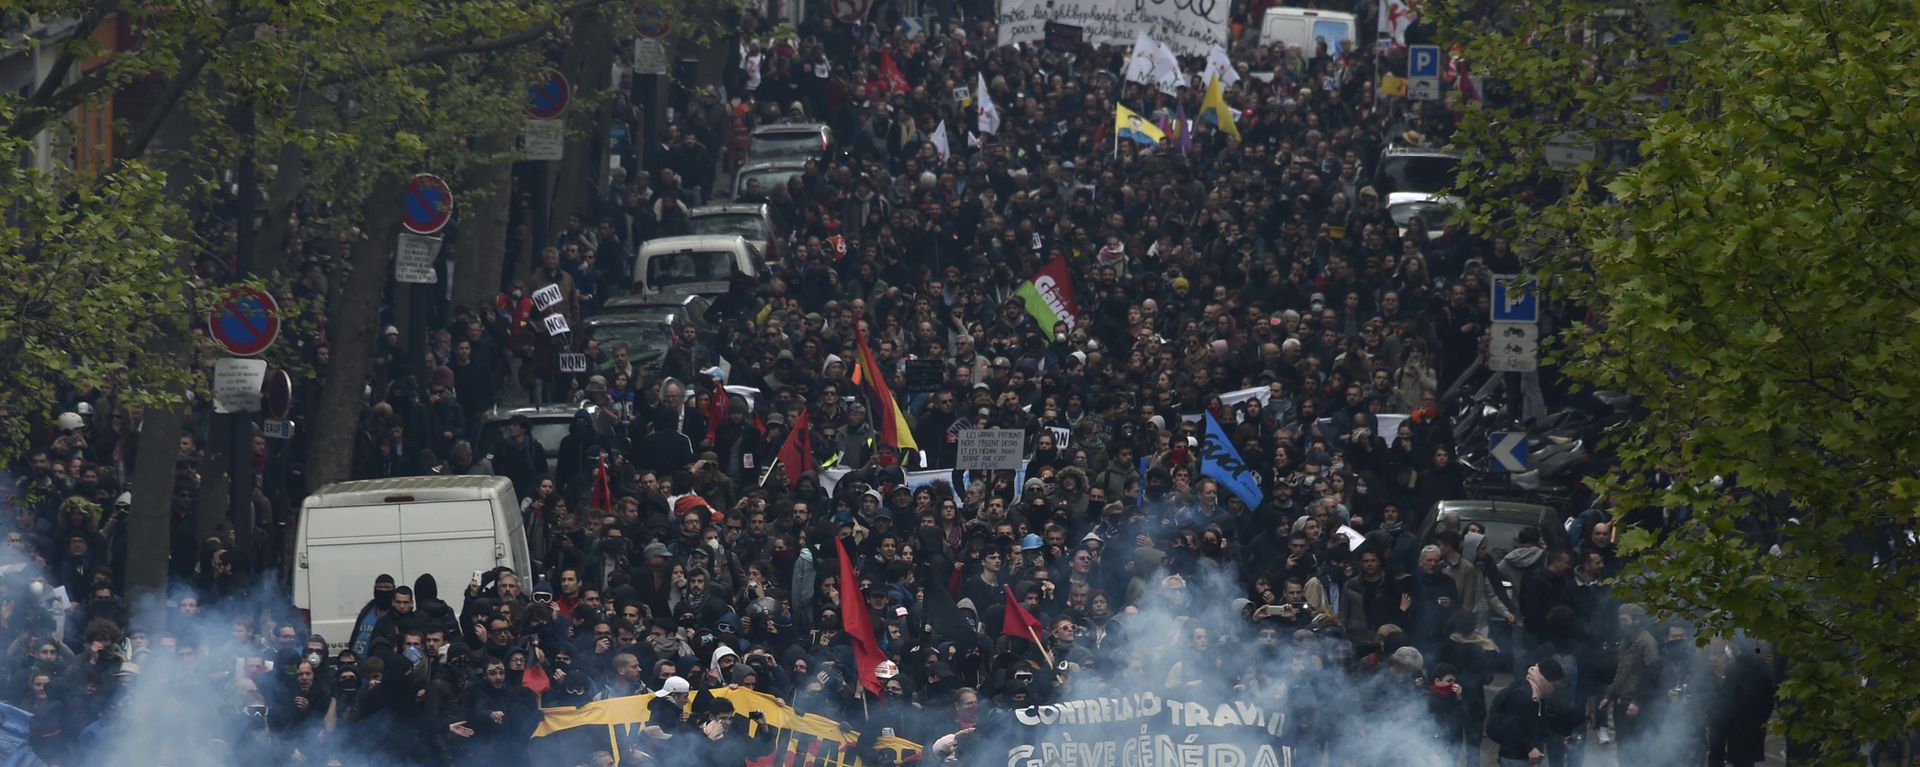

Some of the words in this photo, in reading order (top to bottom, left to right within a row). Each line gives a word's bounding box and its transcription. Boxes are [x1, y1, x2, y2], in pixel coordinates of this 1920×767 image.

[1417, 52, 1431, 72] P
[534, 286, 561, 309] NON!
[1034, 275, 1076, 334] Gauch
[560, 354, 585, 370] NON!
[264, 423, 281, 433] SAUF
[966, 431, 976, 439] LES
[1054, 431, 1069, 447] ON
[1015, 697, 1111, 726] CONTRE
[1111, 696, 1135, 721] LA
[1123, 724, 1296, 767] GÉNÉRAL
